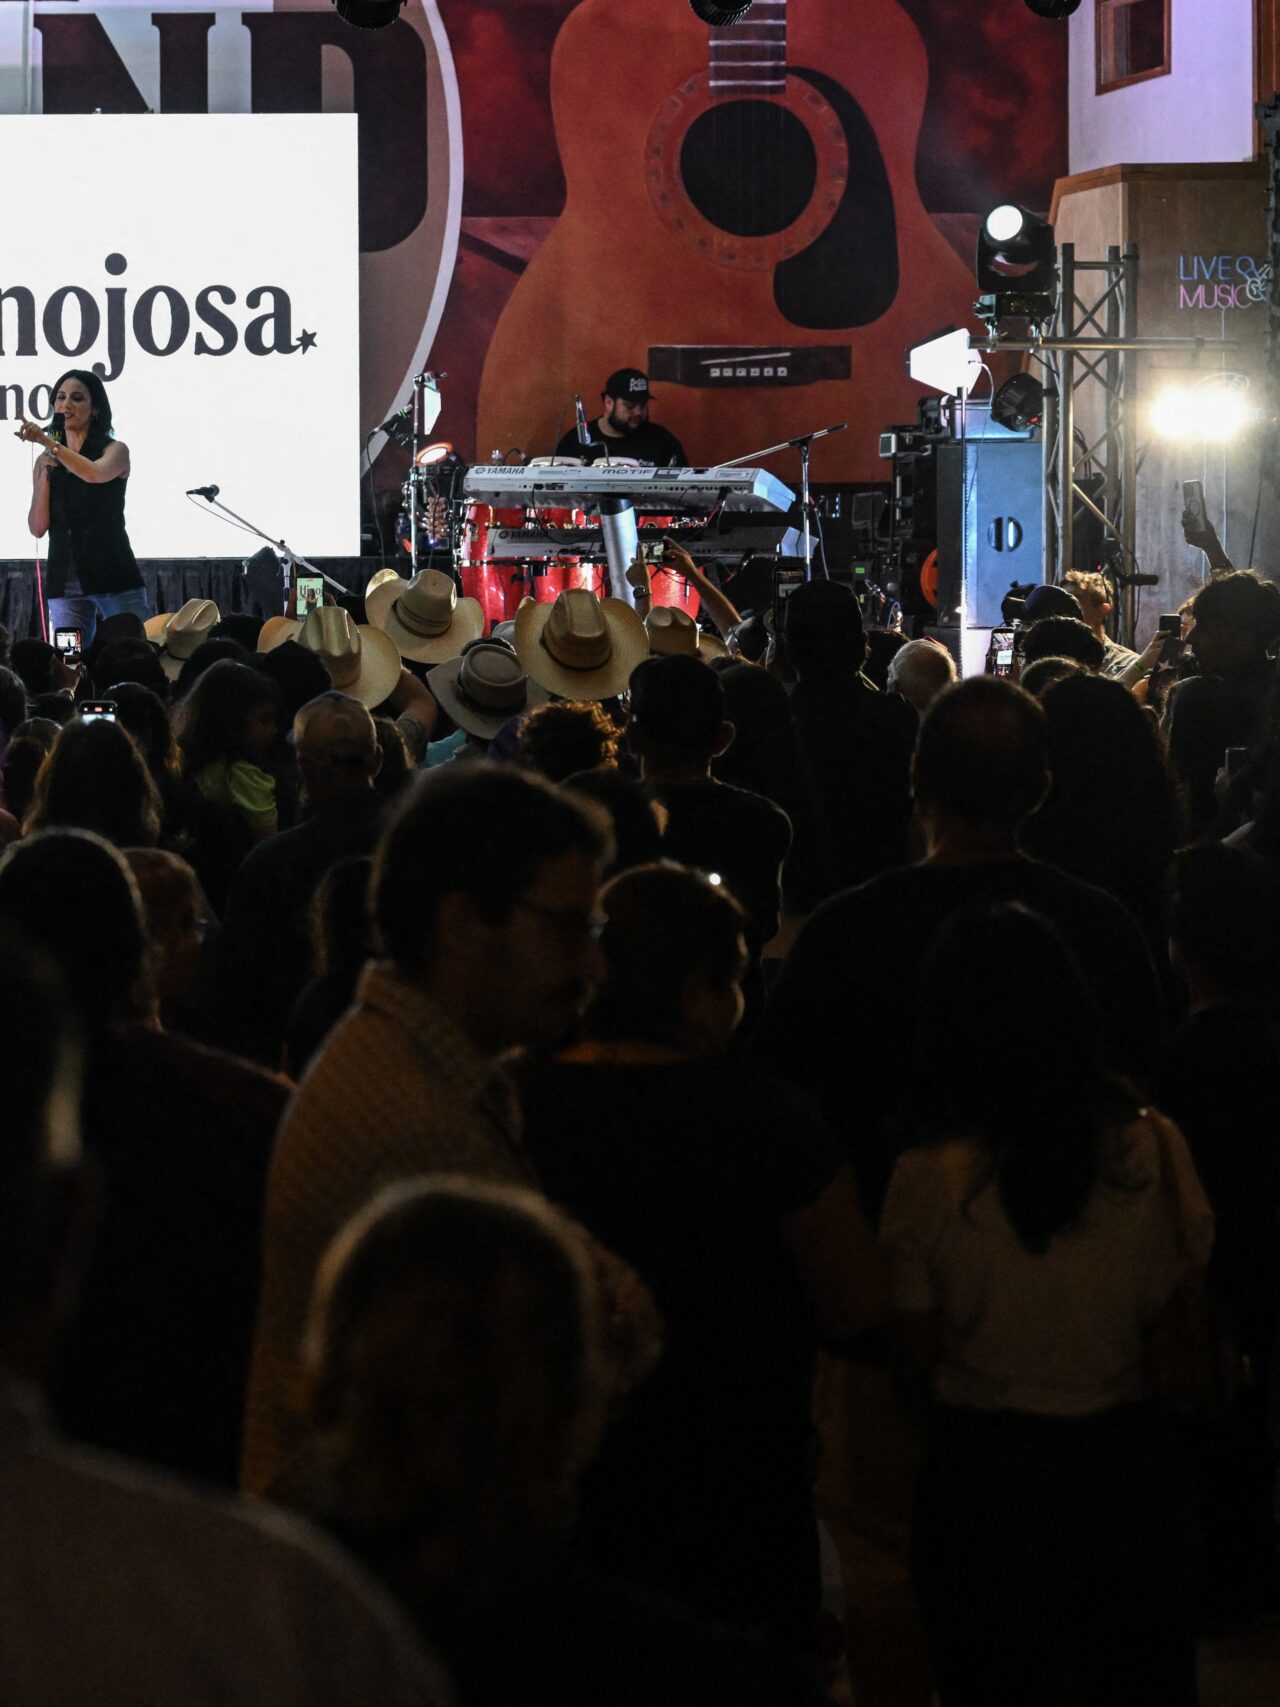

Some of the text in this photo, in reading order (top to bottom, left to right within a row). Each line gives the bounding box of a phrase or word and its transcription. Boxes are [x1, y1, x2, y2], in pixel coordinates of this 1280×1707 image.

[1179, 255, 1233, 280] LIVE
[1179, 284, 1253, 309] MUSIC
[486, 467, 525, 475] YAMAHA
